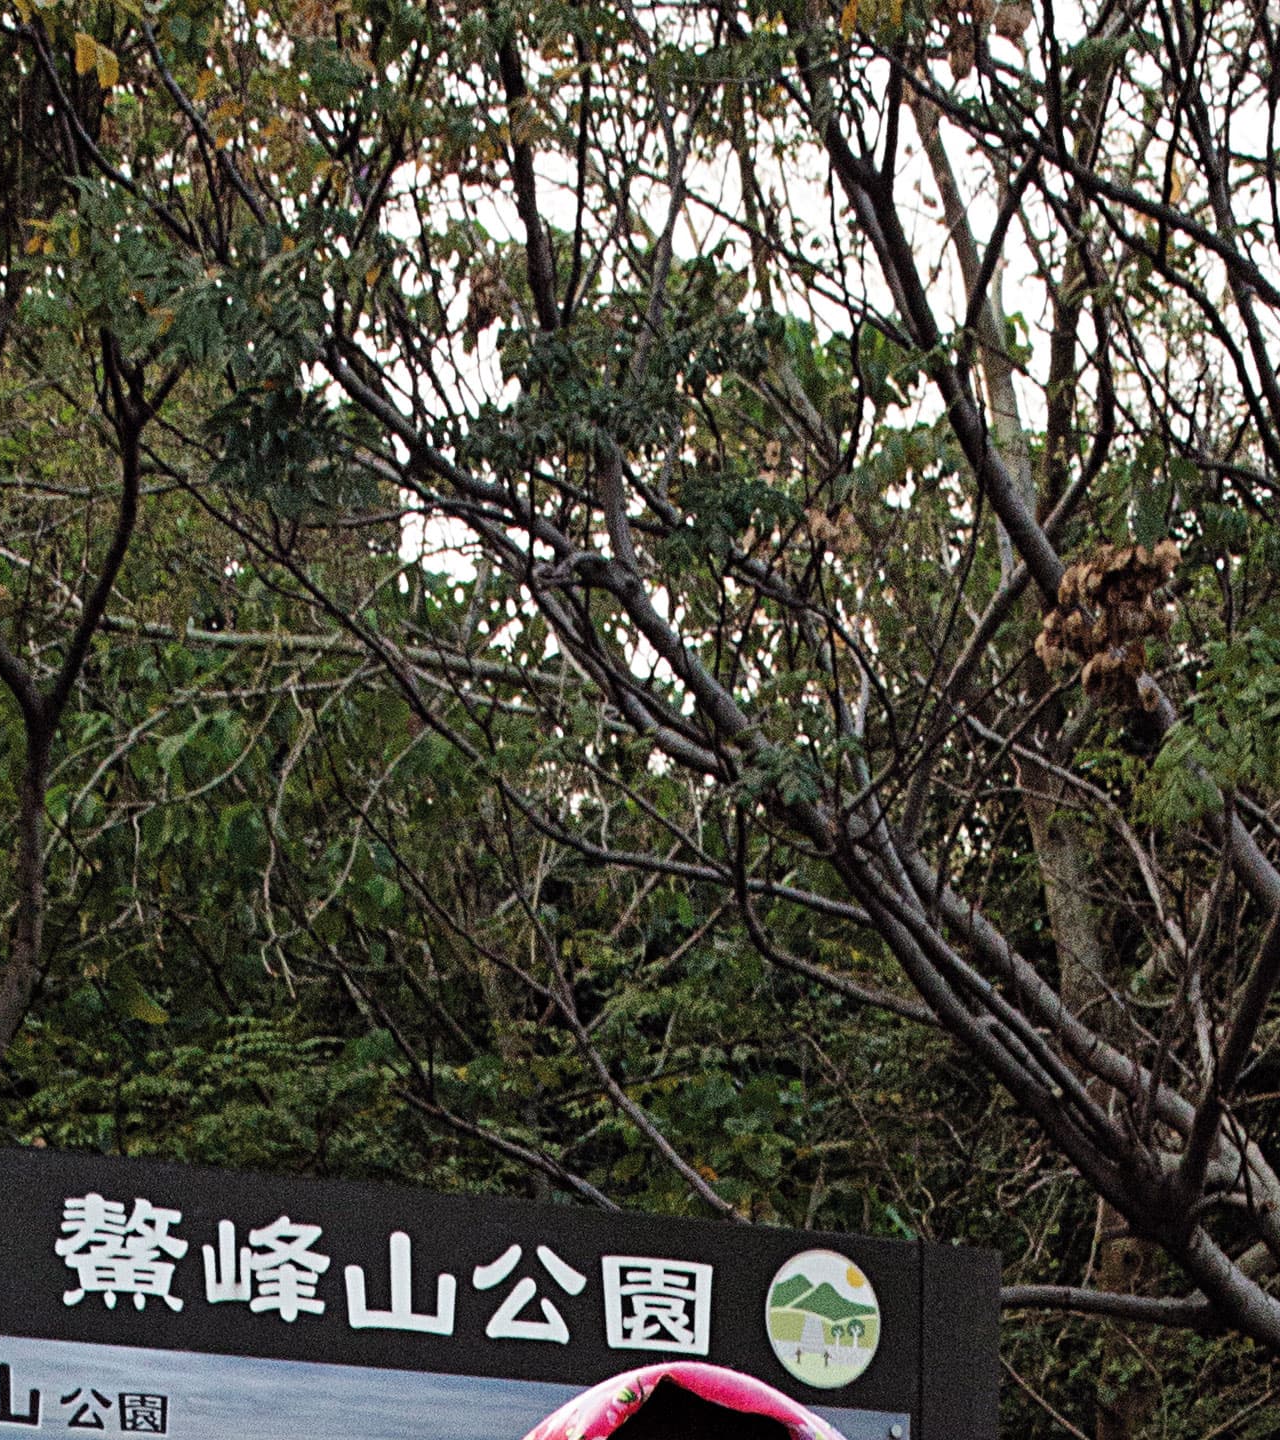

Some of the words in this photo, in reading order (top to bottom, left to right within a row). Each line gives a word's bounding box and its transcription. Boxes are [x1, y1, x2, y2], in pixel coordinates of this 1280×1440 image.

[54, 1192, 715, 1356] 鰲峰山公園
